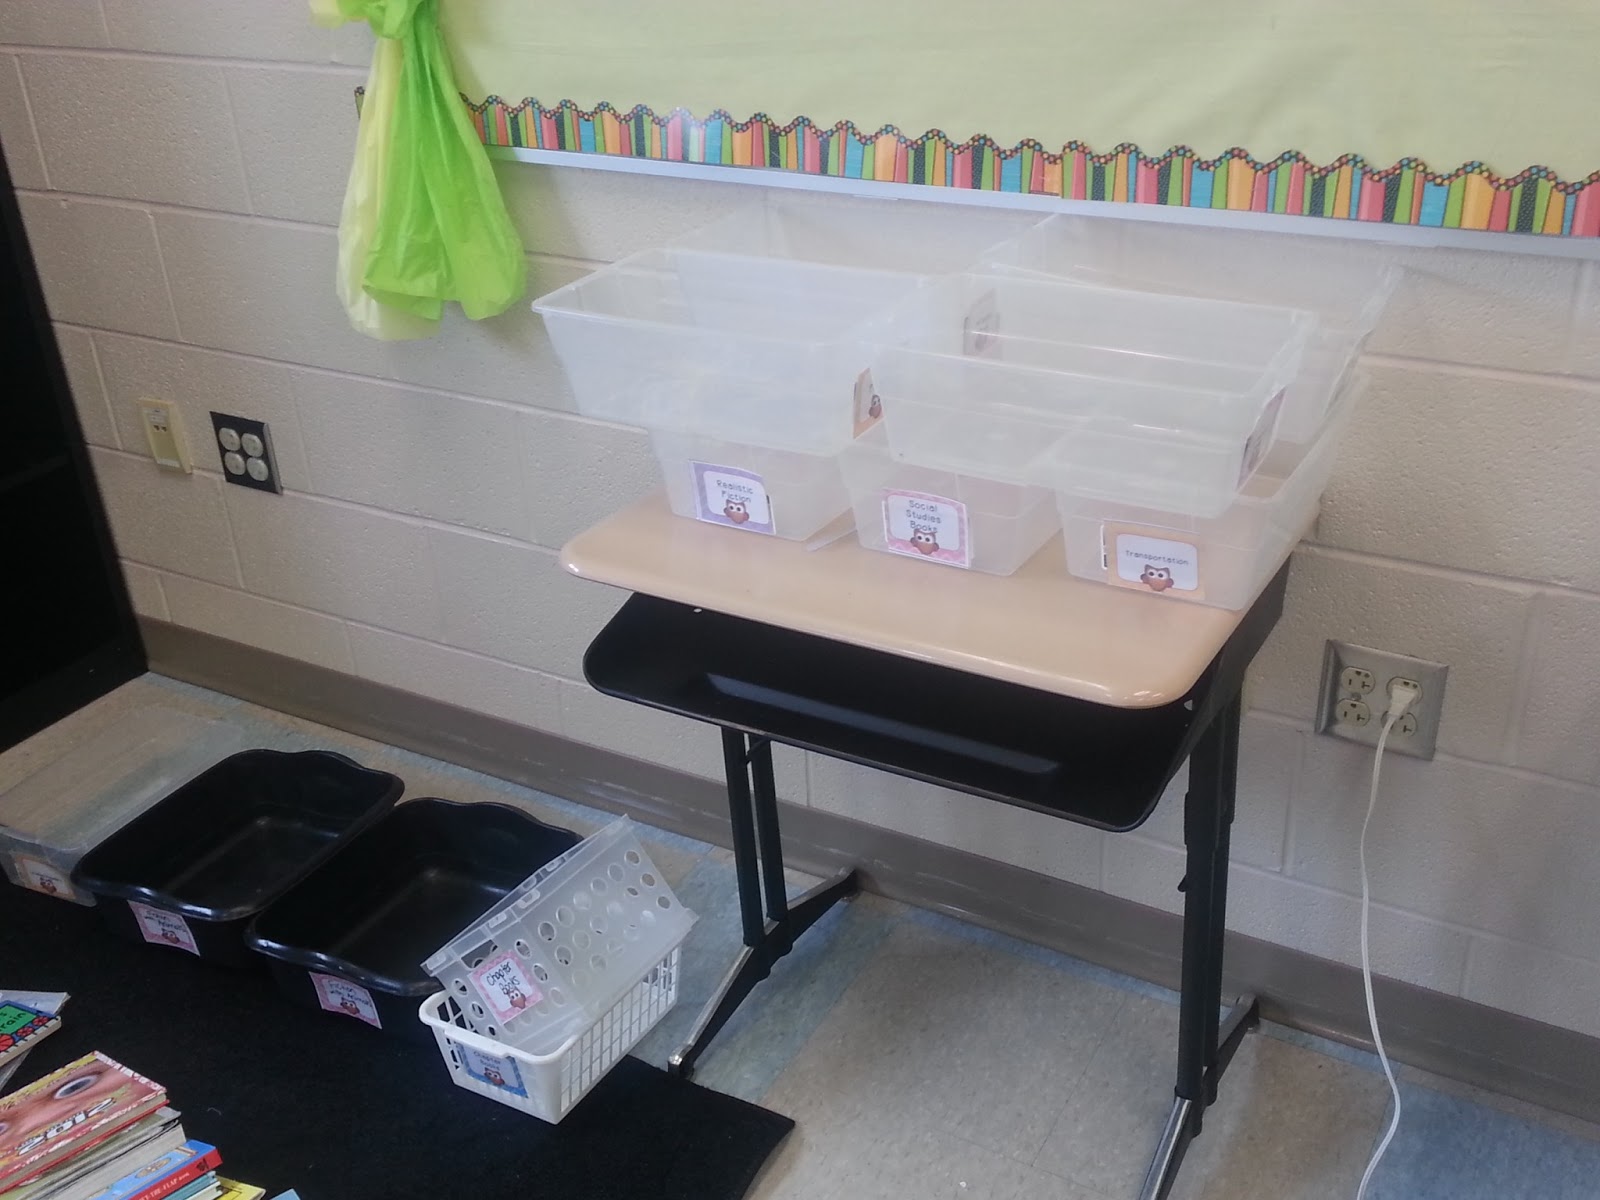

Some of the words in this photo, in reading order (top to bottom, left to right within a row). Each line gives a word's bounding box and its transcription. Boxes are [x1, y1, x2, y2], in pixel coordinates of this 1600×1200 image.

[717, 480, 753, 494] Realistic
[721, 490, 751, 503] Fiction
[908, 500, 937, 512] Social
[906, 509, 942, 524] Studies
[910, 520, 938, 533] Books
[1125, 549, 1190, 565] Transportation
[486, 961, 512, 987] Chapter
[0, 1011, 27, 1032] rain
